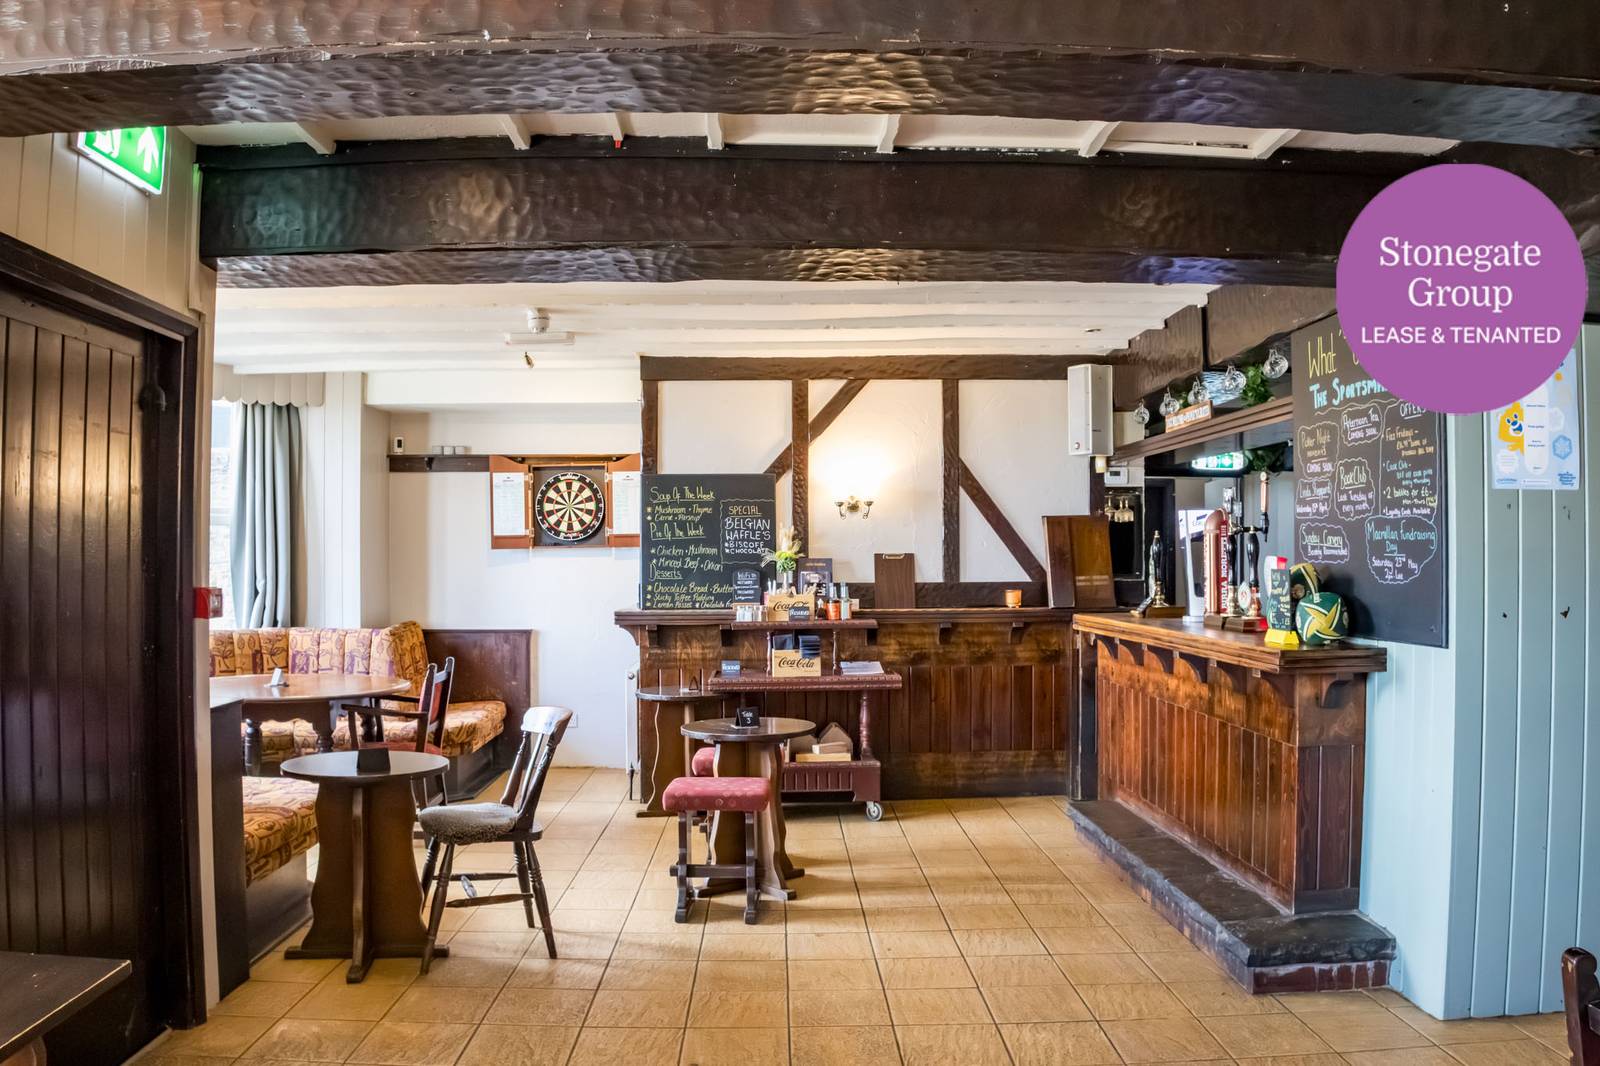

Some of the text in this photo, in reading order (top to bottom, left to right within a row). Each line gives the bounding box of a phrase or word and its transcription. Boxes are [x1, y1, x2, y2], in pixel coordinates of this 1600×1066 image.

[1340, 466, 1366, 489] Book Club
[650, 486, 671, 504] Soup
[696, 486, 716, 500] Week
[654, 504, 687, 514] Mushroom
[728, 505, 762, 515] SPECIAL
[686, 522, 705, 537] Week
[724, 516, 771, 531] BELGIAN
[725, 530, 771, 541] WAFFLE'S
[1302, 526, 1320, 551] Sunday
[656, 543, 718, 556] Chicken Mushroom
[730, 541, 764, 550] BISCOFF
[649, 562, 682, 581] Desserts
[653, 582, 687, 593] Chocolate
[689, 582, 709, 593] Bread
